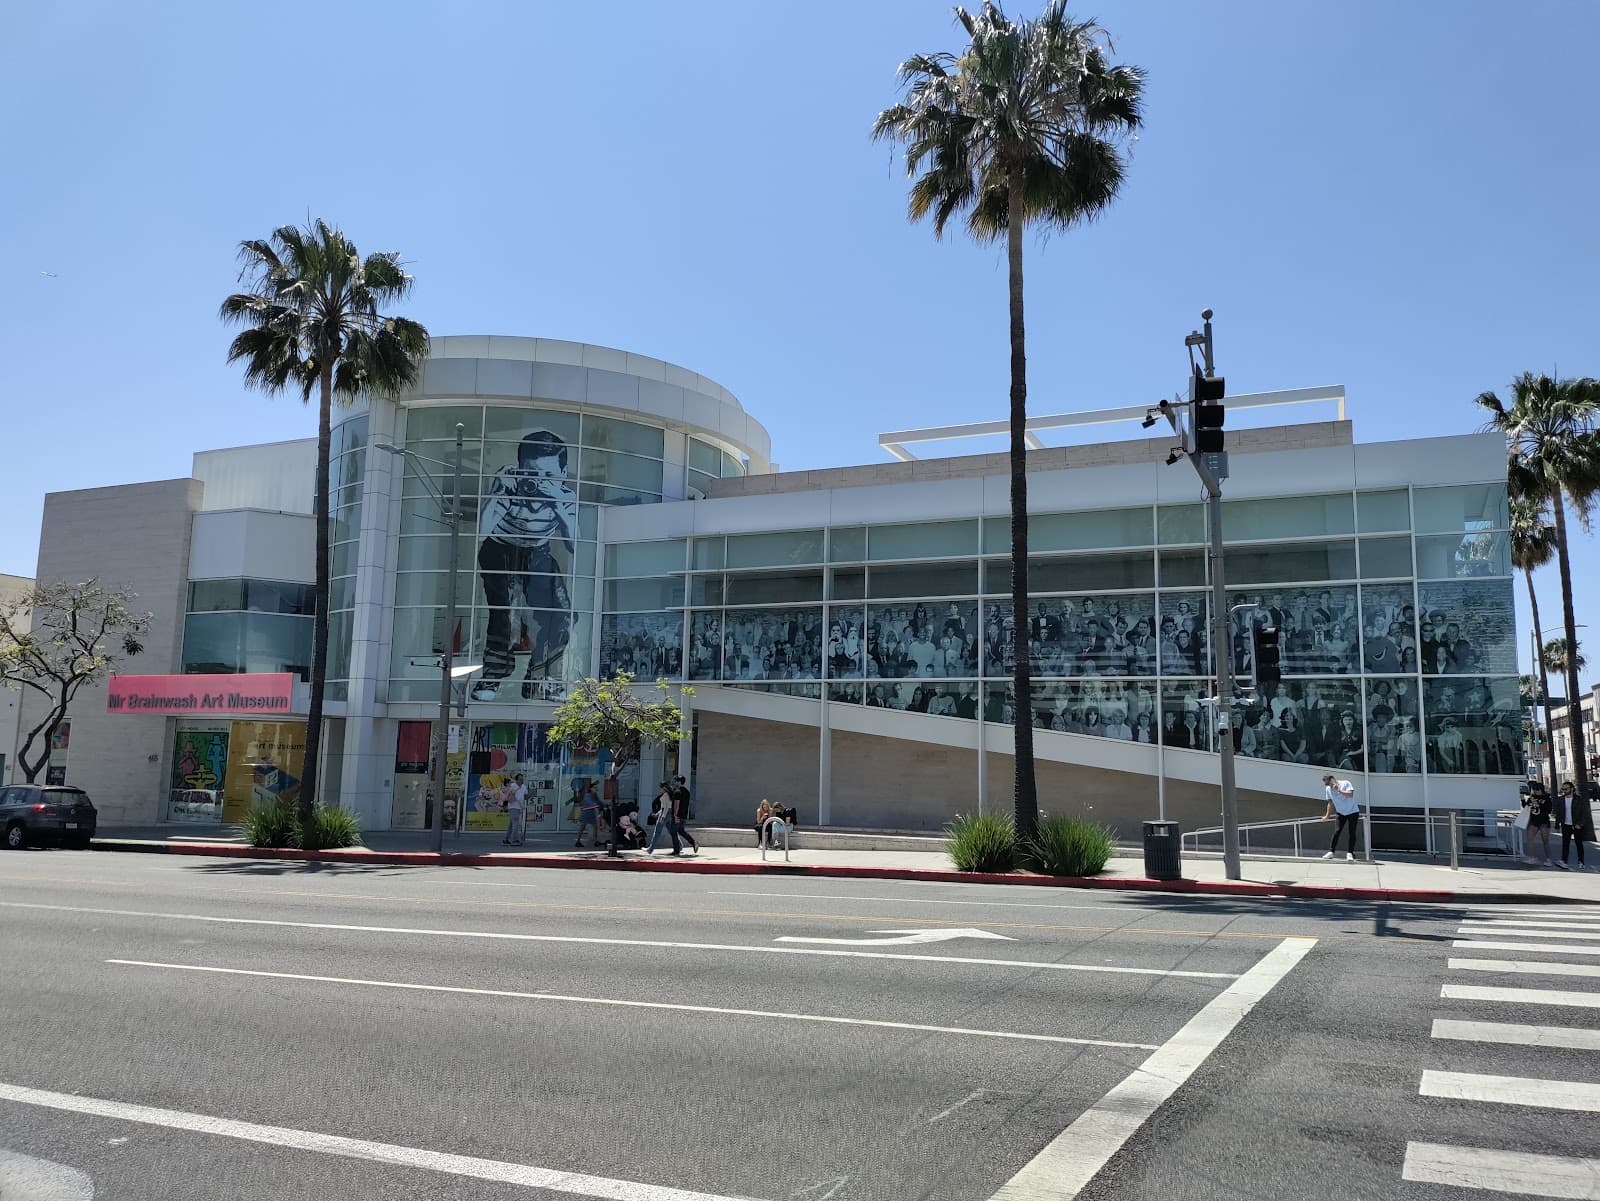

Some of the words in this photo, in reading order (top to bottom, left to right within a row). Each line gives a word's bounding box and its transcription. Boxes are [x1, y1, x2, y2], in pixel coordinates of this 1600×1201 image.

[108, 694, 126, 709] Mr
[128, 693, 197, 709] Brainwash
[200, 693, 224, 708] Art
[227, 693, 288, 708] Museum
[471, 726, 495, 752] ART
